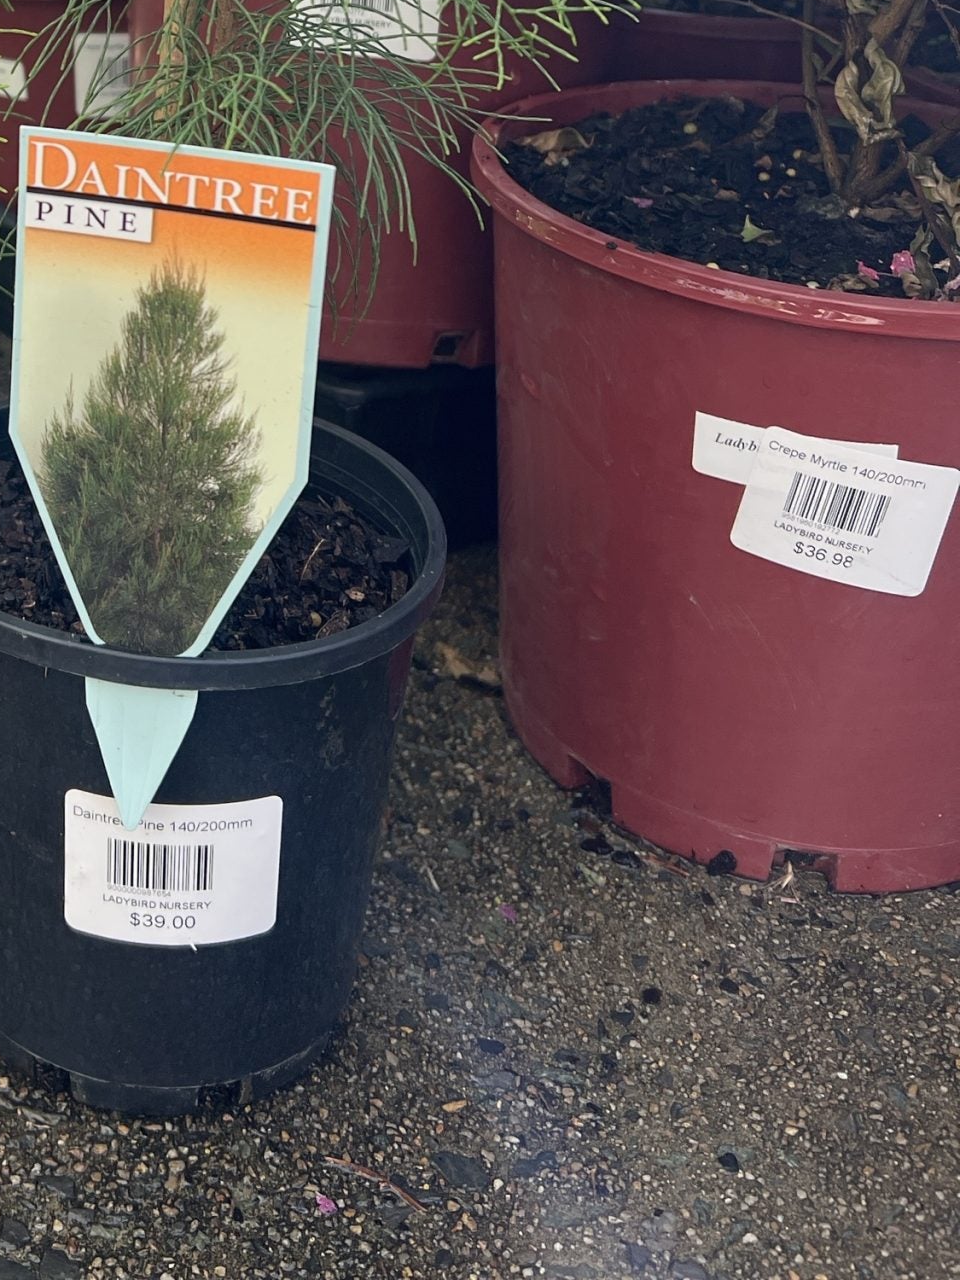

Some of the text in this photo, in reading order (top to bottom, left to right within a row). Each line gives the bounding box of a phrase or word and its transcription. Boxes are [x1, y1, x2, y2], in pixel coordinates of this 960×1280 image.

[30, 141, 313, 225] DAINTREE
[35, 201, 137, 232] PINE
[769, 440, 927, 490] Crepe Myrtle 140/200mm
[774, 521, 875, 555] LADYBIRD NURSERY
[793, 541, 854, 569] $36.98
[170, 818, 253, 832] 140/200mm
[103, 894, 212, 910] LADYBIRD NURSERY
[129, 912, 196, 929] $39.00
